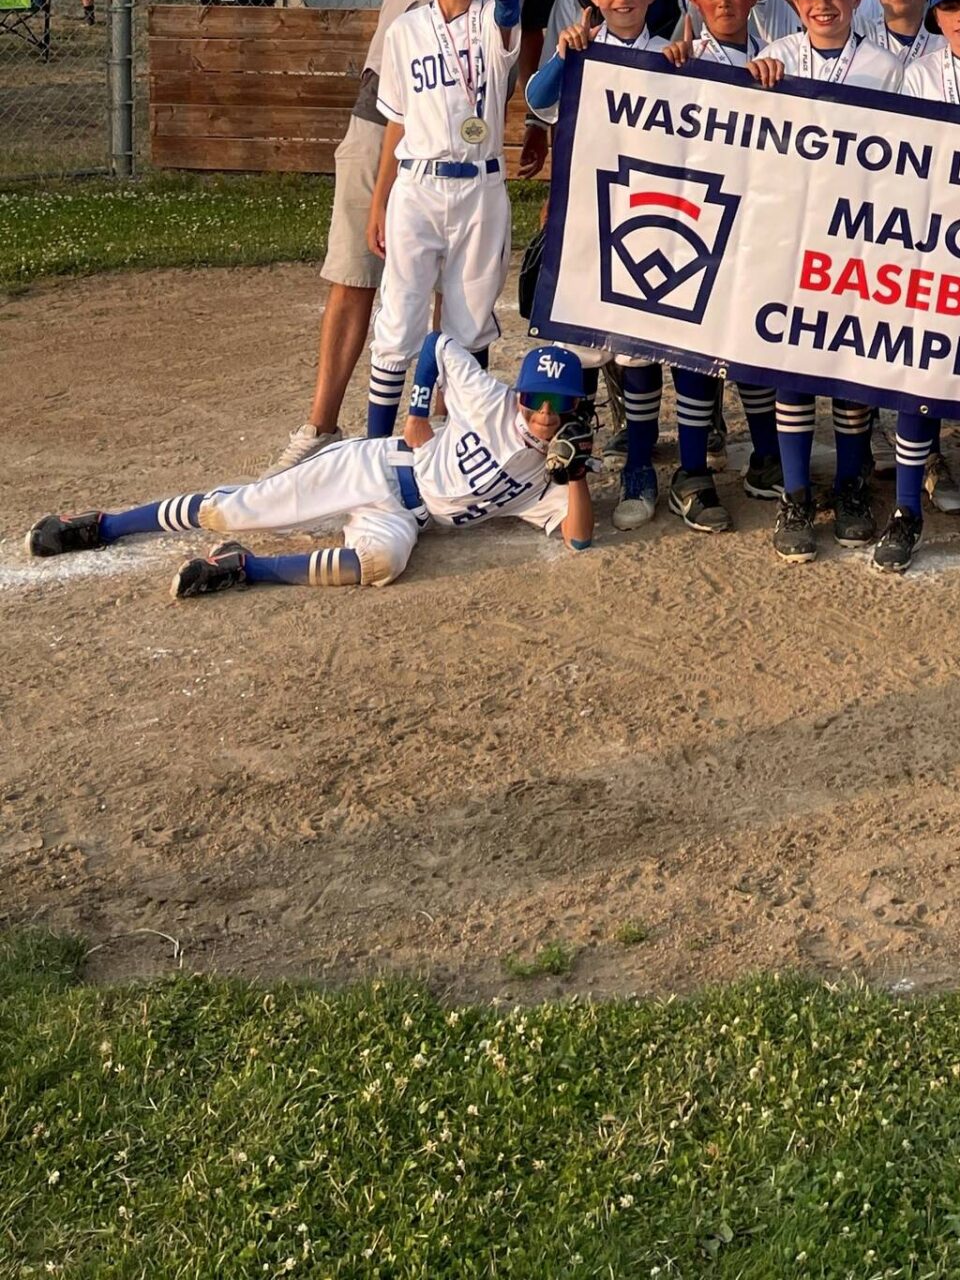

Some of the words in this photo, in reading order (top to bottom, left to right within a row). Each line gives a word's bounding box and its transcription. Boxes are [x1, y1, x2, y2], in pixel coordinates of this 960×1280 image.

[605, 89, 933, 180] WASHINGTON
[537, 353, 565, 380] SW
[409, 384, 431, 410] 32
